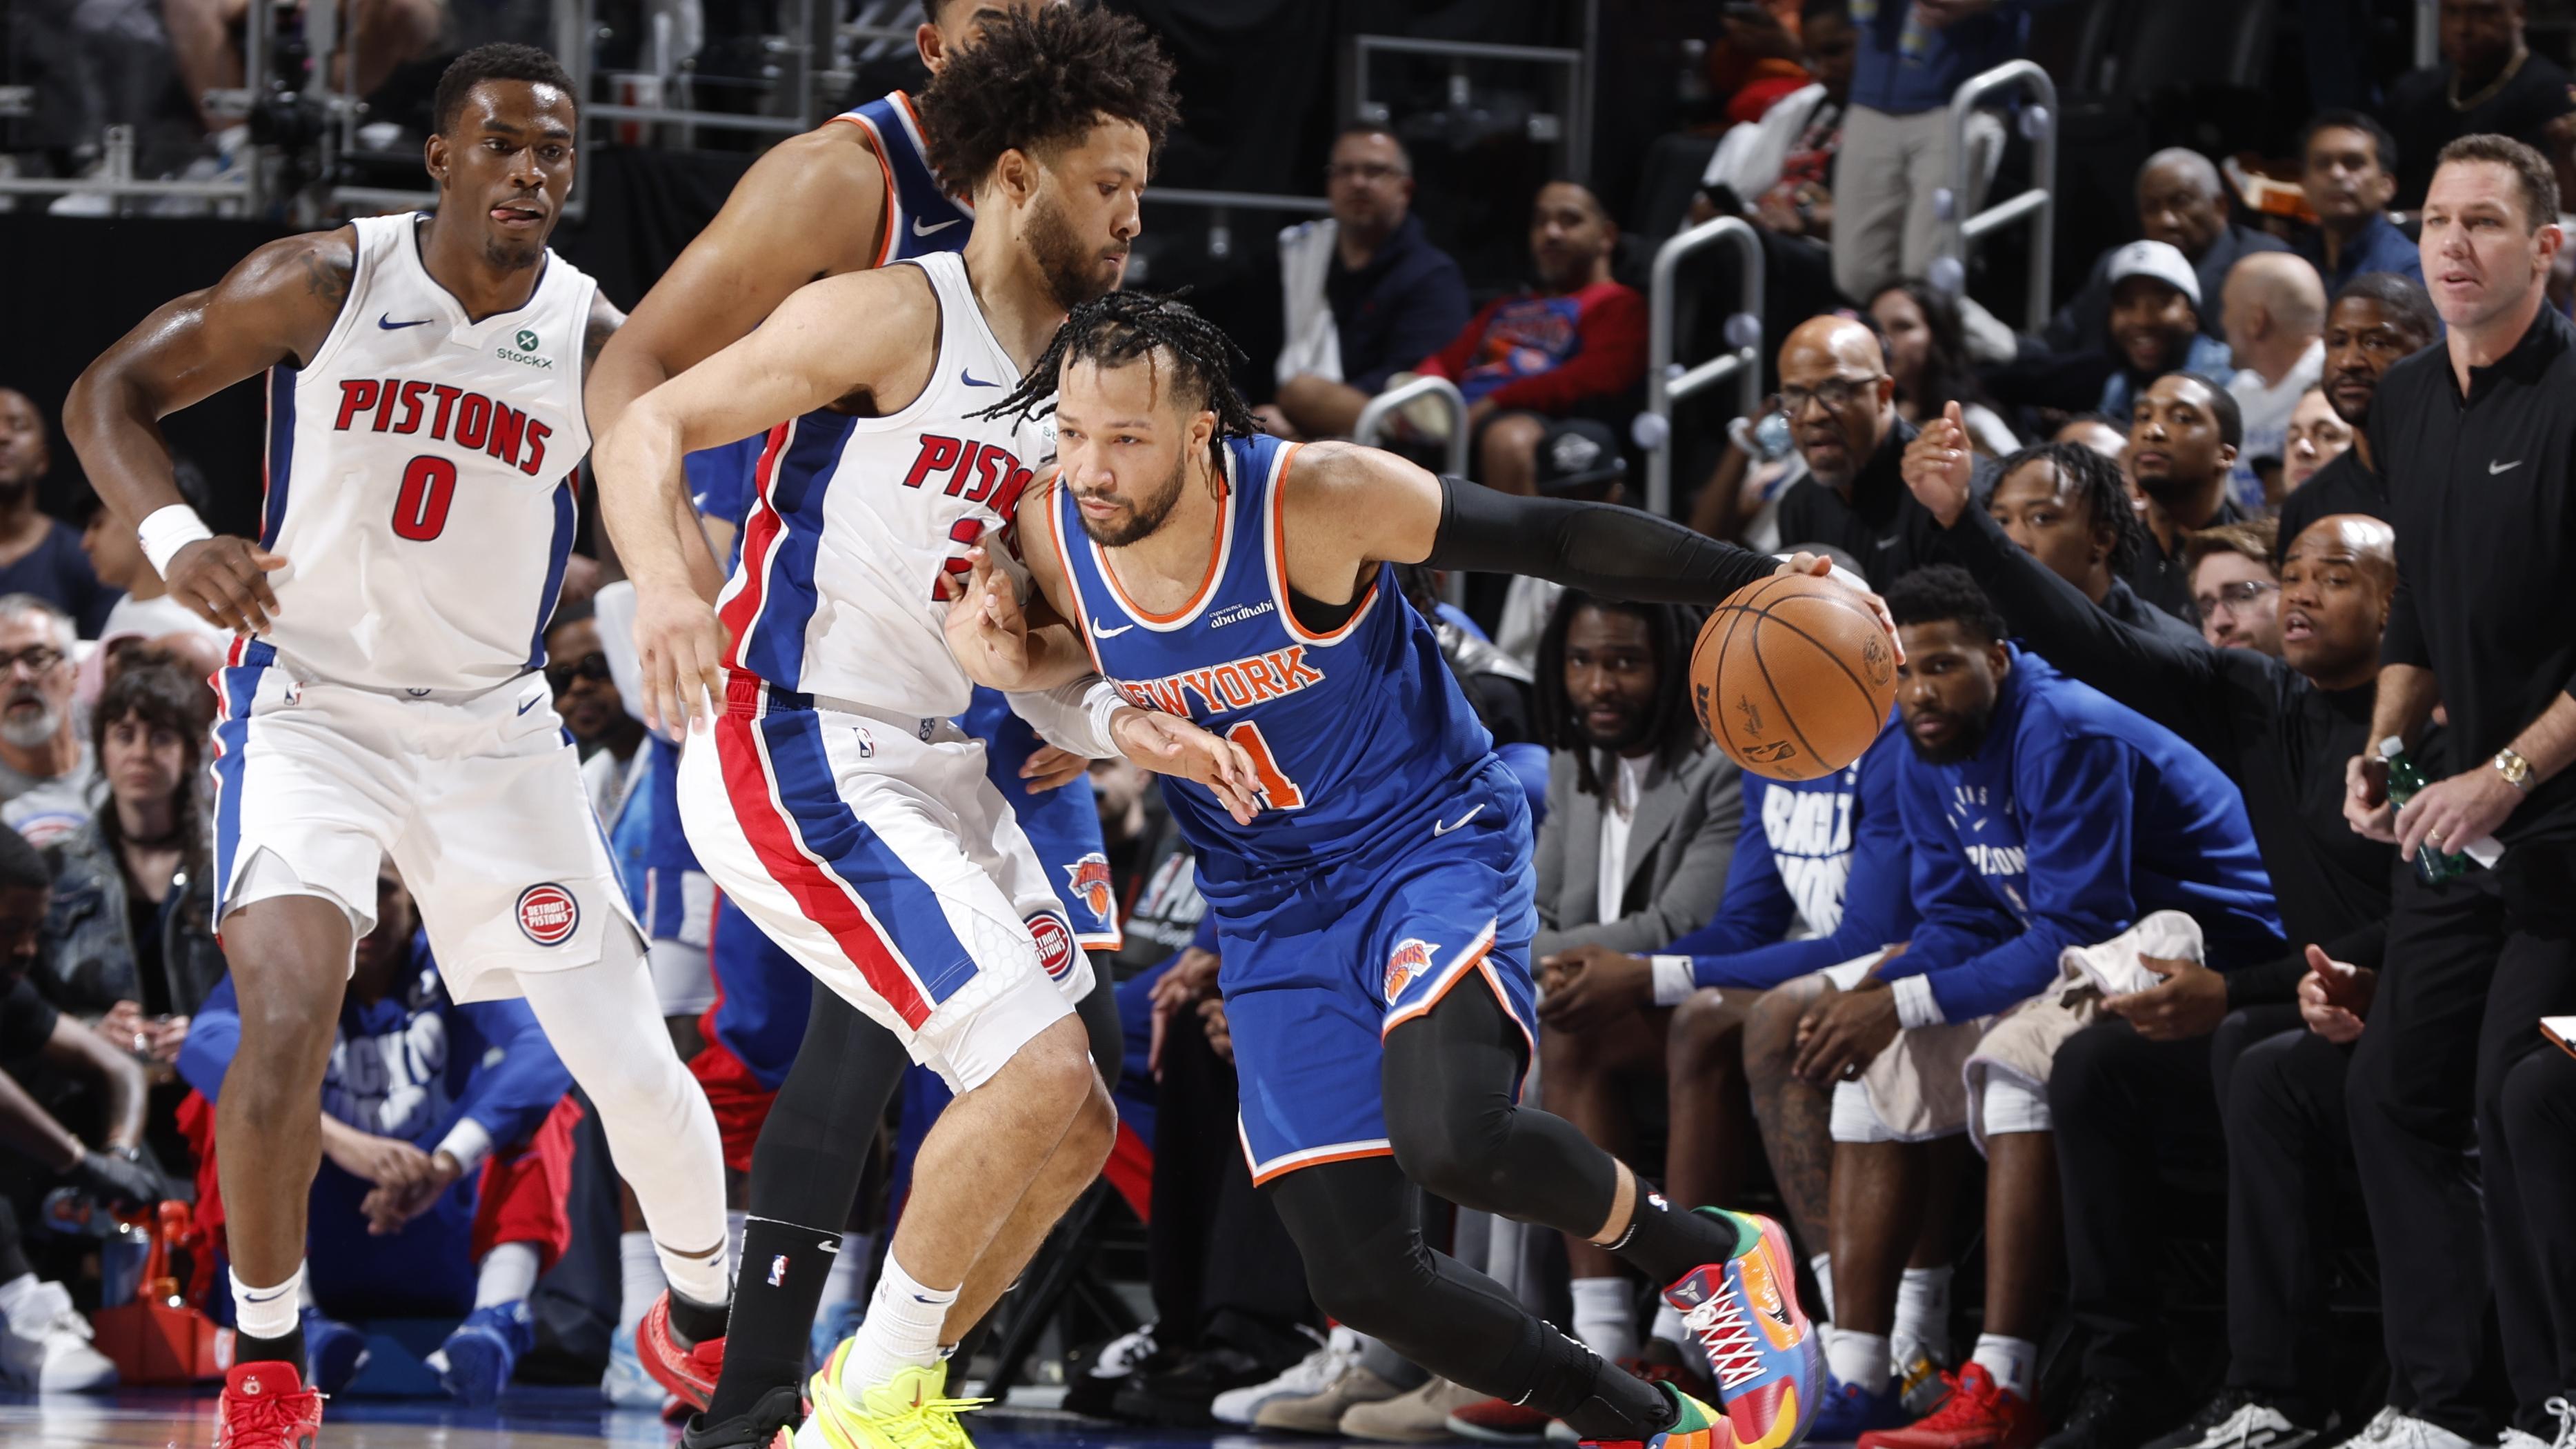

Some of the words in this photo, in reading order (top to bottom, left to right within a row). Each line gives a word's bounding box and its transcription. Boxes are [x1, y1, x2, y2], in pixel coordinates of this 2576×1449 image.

[496, 347, 553, 370] StockX
[333, 379, 553, 477] PISTONS
[391, 454, 457, 542] 0
[1209, 603, 1242, 618] experience
[1211, 613, 1237, 629] abu
[1237, 599, 1275, 621] dhabi
[1182, 643, 1326, 714] YORK
[526, 900, 566, 917] DETROIT
[528, 911, 569, 928] PISTONS
[1034, 927, 1061, 950] TROIT
[1035, 938, 1066, 963] ISTONS
